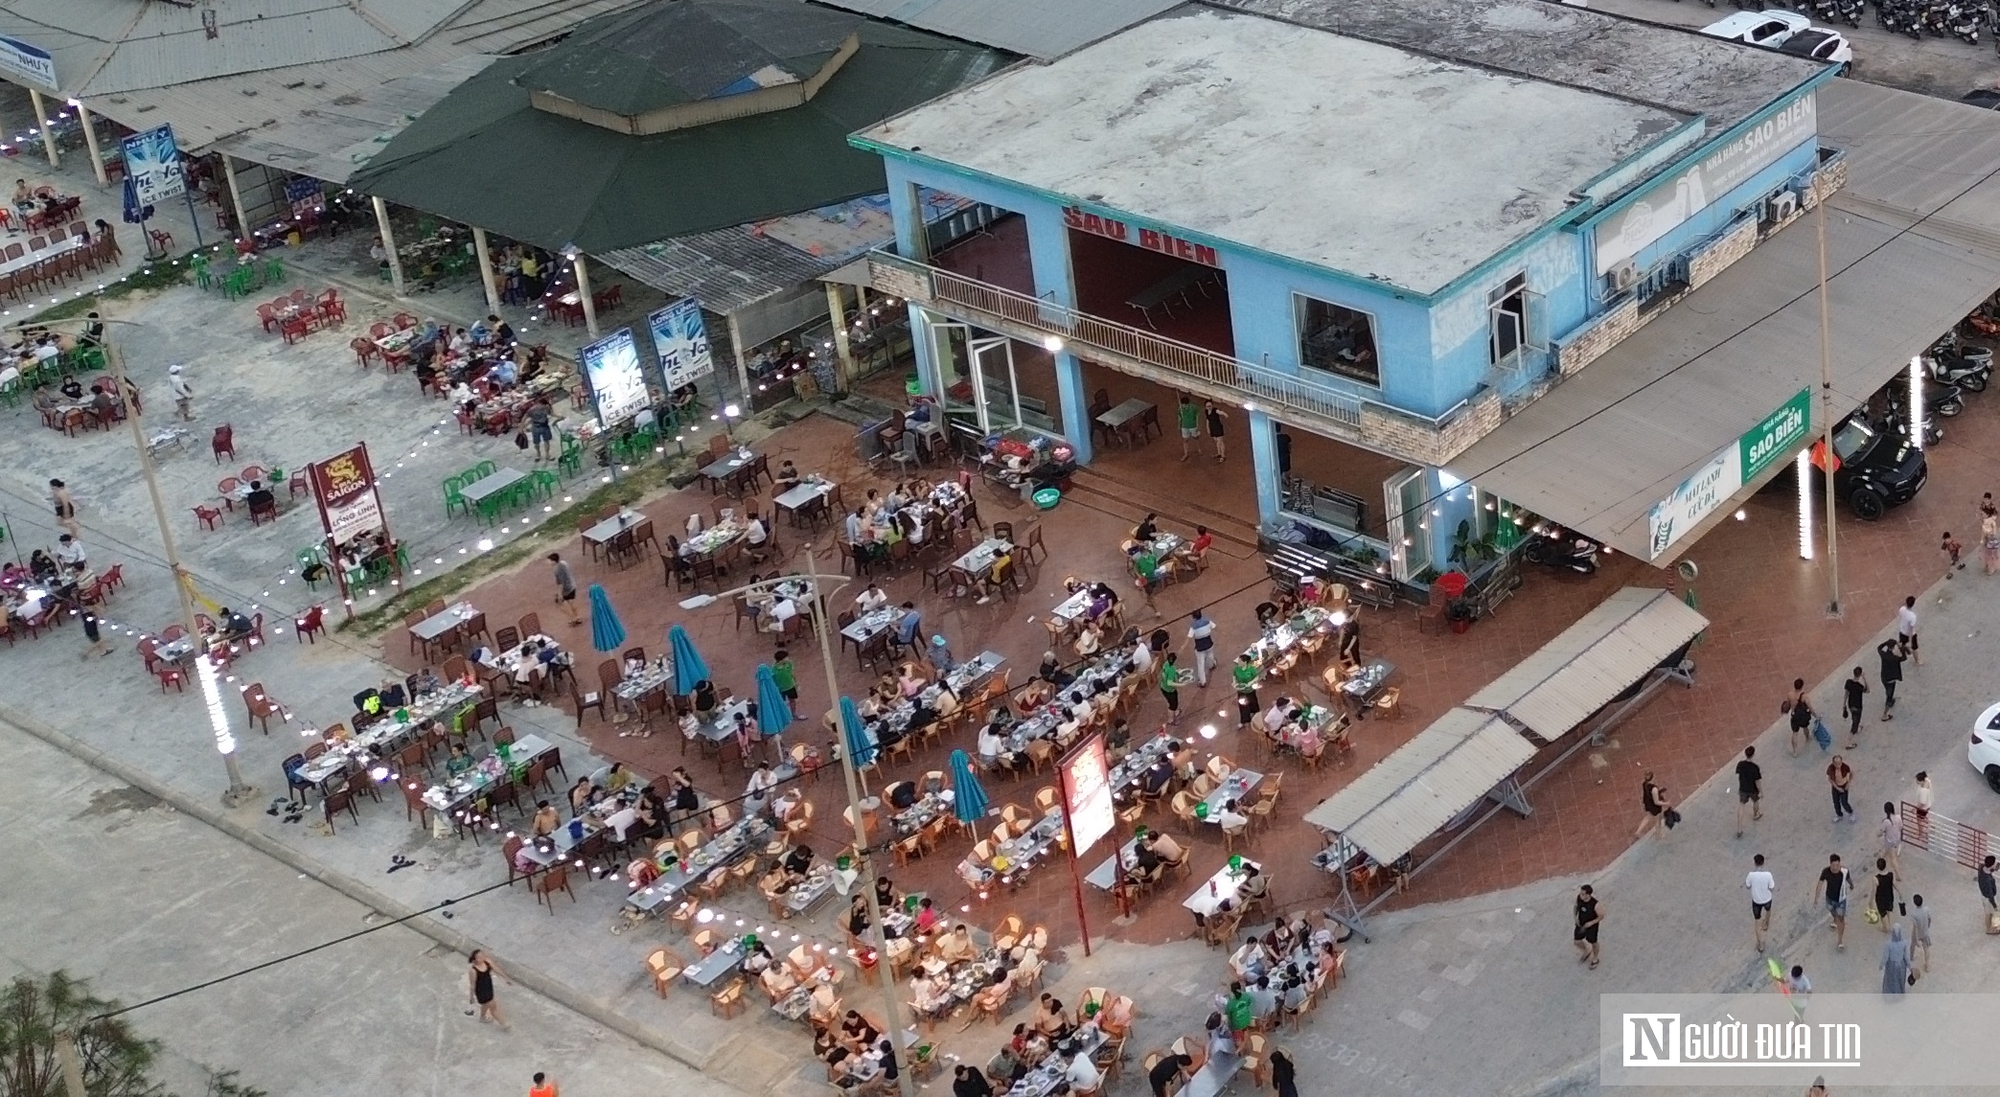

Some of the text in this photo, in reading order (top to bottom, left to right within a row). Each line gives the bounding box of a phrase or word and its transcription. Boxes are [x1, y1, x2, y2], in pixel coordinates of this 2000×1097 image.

[1744, 120, 1774, 154] SAO
[142, 184, 182, 204] ICE TWIST
[651, 301, 696, 326] LONG LINH
[586, 344, 607, 359] SAO
[669, 363, 710, 389] ICE TWIST
[605, 396, 646, 422] ICE TWIST
[1749, 432, 1774, 464] SAO
[1775, 406, 1803, 443] BIỂN
[327, 478, 366, 501] SAIGON
[357, 502, 376, 516] LINH
